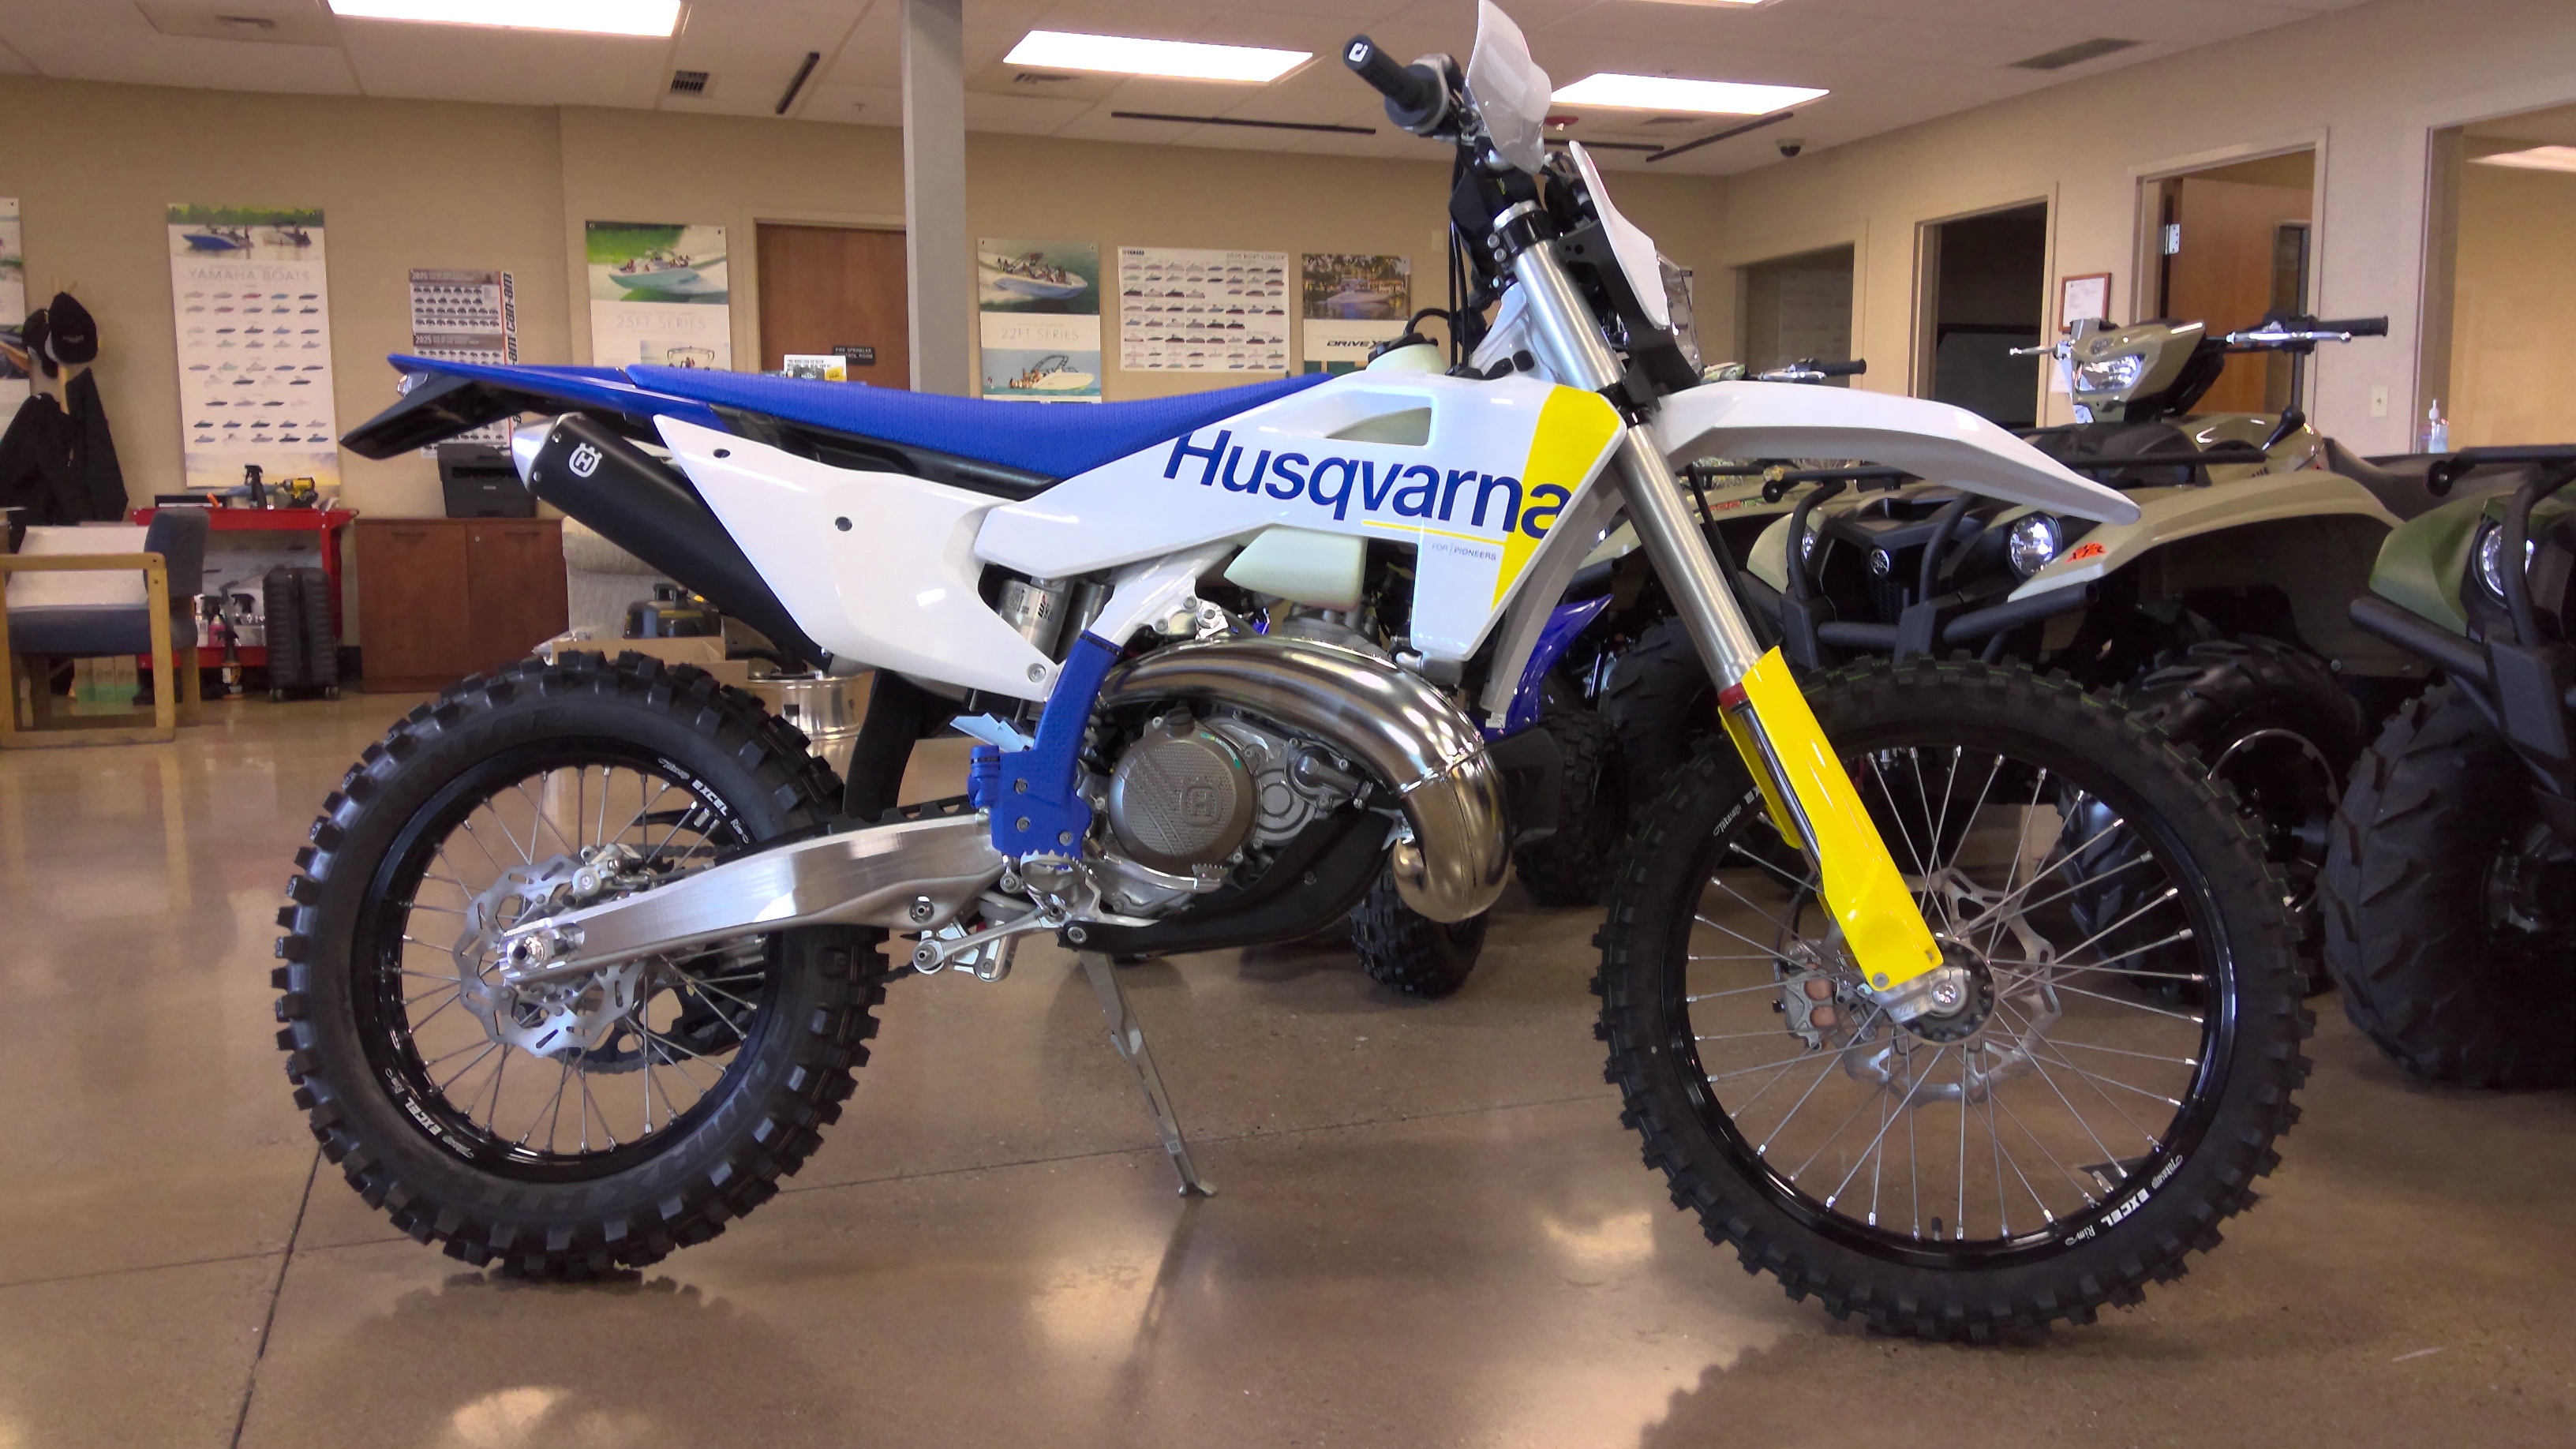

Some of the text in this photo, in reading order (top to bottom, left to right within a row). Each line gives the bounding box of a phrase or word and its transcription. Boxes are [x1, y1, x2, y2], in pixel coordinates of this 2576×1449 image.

[189, 268, 310, 283] YAMAHA BOATS
[616, 316, 706, 331] 25FT SERIES
[1001, 327, 1080, 341] 22FT SERIES
[1163, 429, 1572, 540] Husqvarna
[1432, 542, 1497, 561] FOR PIONEERS
[691, 779, 728, 817] EXCEL
[405, 1096, 443, 1136] EXCEL
[2100, 1187, 2151, 1227] EXCEL
